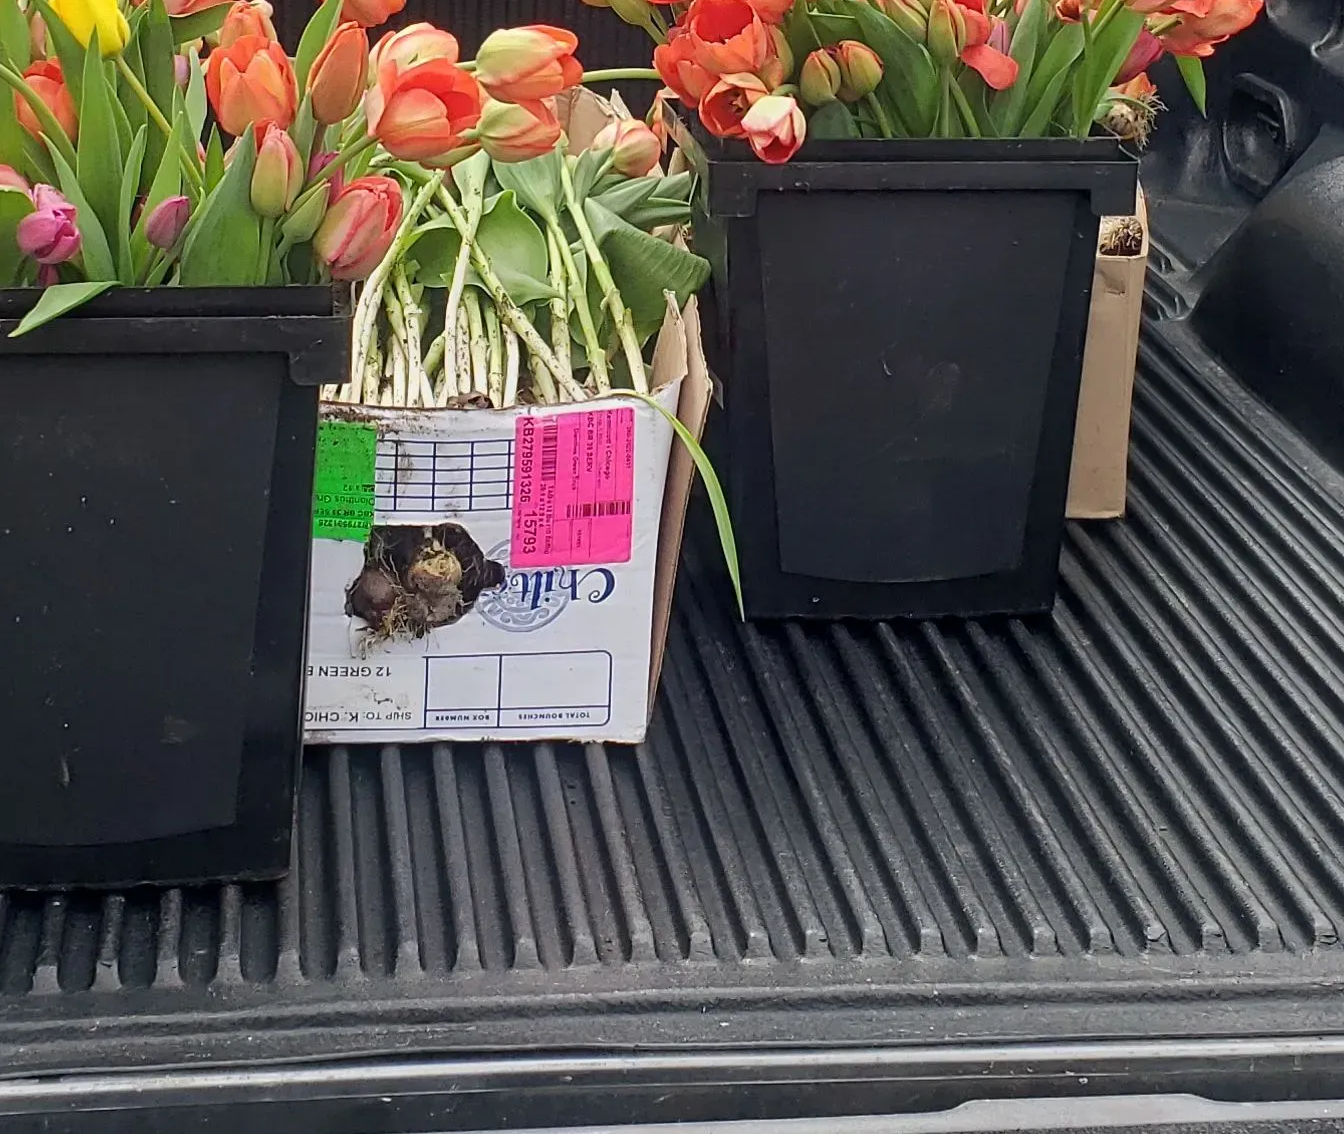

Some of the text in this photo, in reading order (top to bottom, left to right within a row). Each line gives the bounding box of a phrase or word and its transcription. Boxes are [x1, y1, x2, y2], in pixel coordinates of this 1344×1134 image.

[519, 417, 535, 503] KB279591326
[523, 510, 538, 555] 15793
[494, 566, 615, 610] Chilt
[319, 666, 372, 677] GREEN
[376, 666, 392, 677] 12
[386, 711, 412, 720] SHIP
[435, 714, 470, 722] NUMBER
[567, 711, 590, 719] TOTAL
